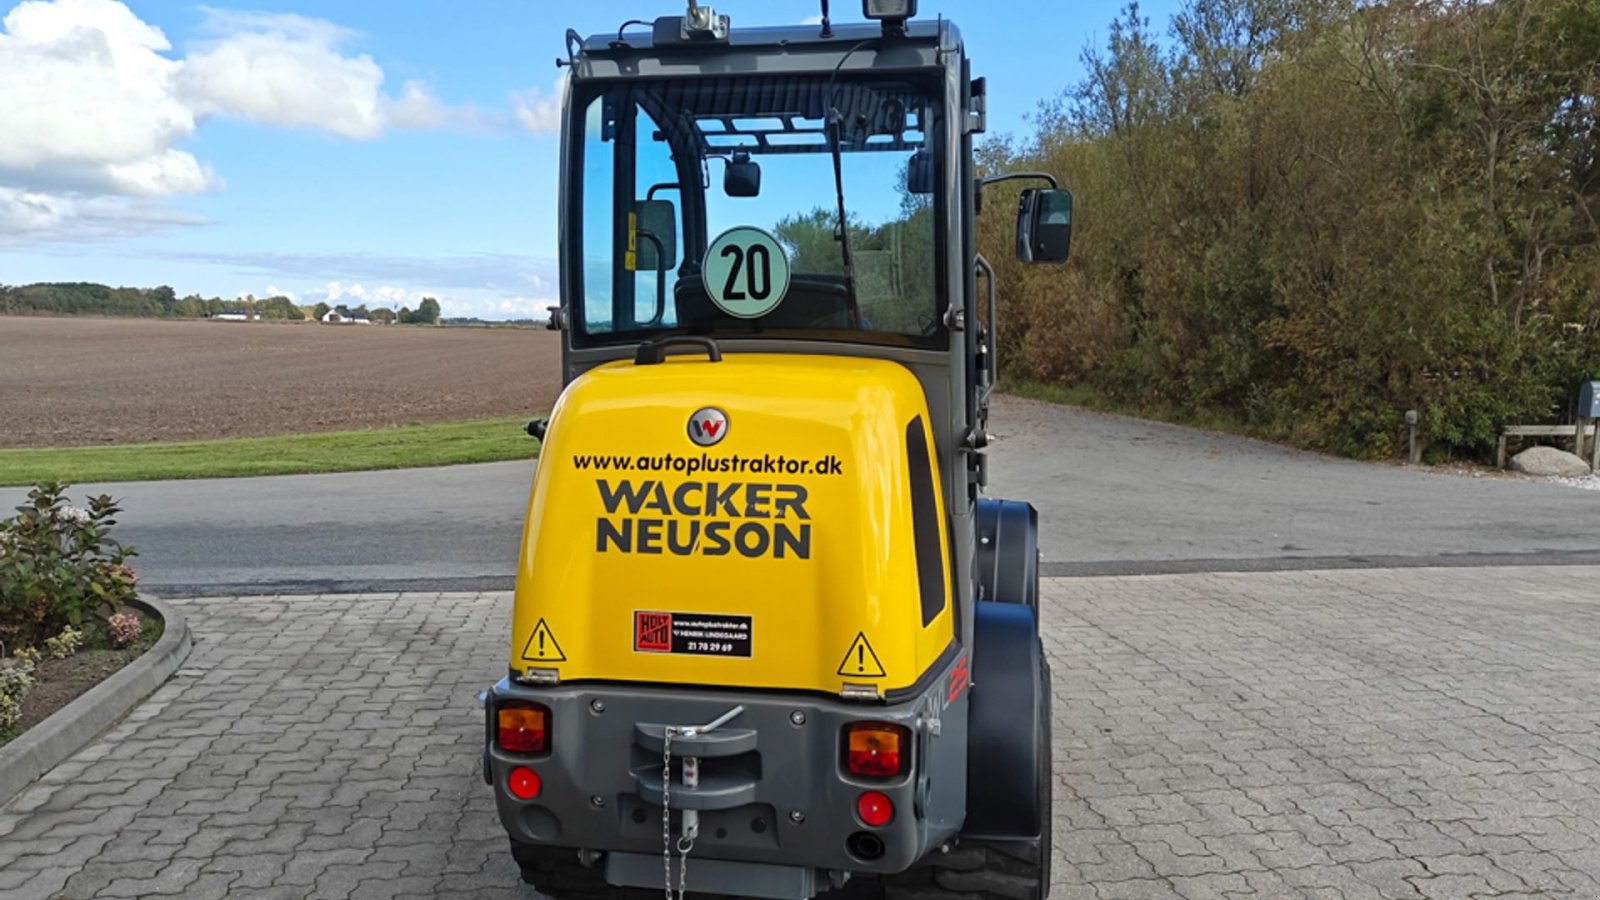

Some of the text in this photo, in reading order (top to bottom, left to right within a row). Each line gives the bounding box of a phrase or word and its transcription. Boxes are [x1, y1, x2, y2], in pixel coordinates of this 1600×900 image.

[720, 243, 771, 301] 20
[573, 454, 843, 476] www.autoplustraktor.dk
[596, 479, 811, 520] WACKER
[596, 517, 811, 560] NEUSON
[641, 615, 670, 635] HOLT
[673, 620, 748, 630] www.autoplustraktor.dk
[680, 630, 704, 638] HENRIK
[688, 642, 733, 652] 21 78 29 69
